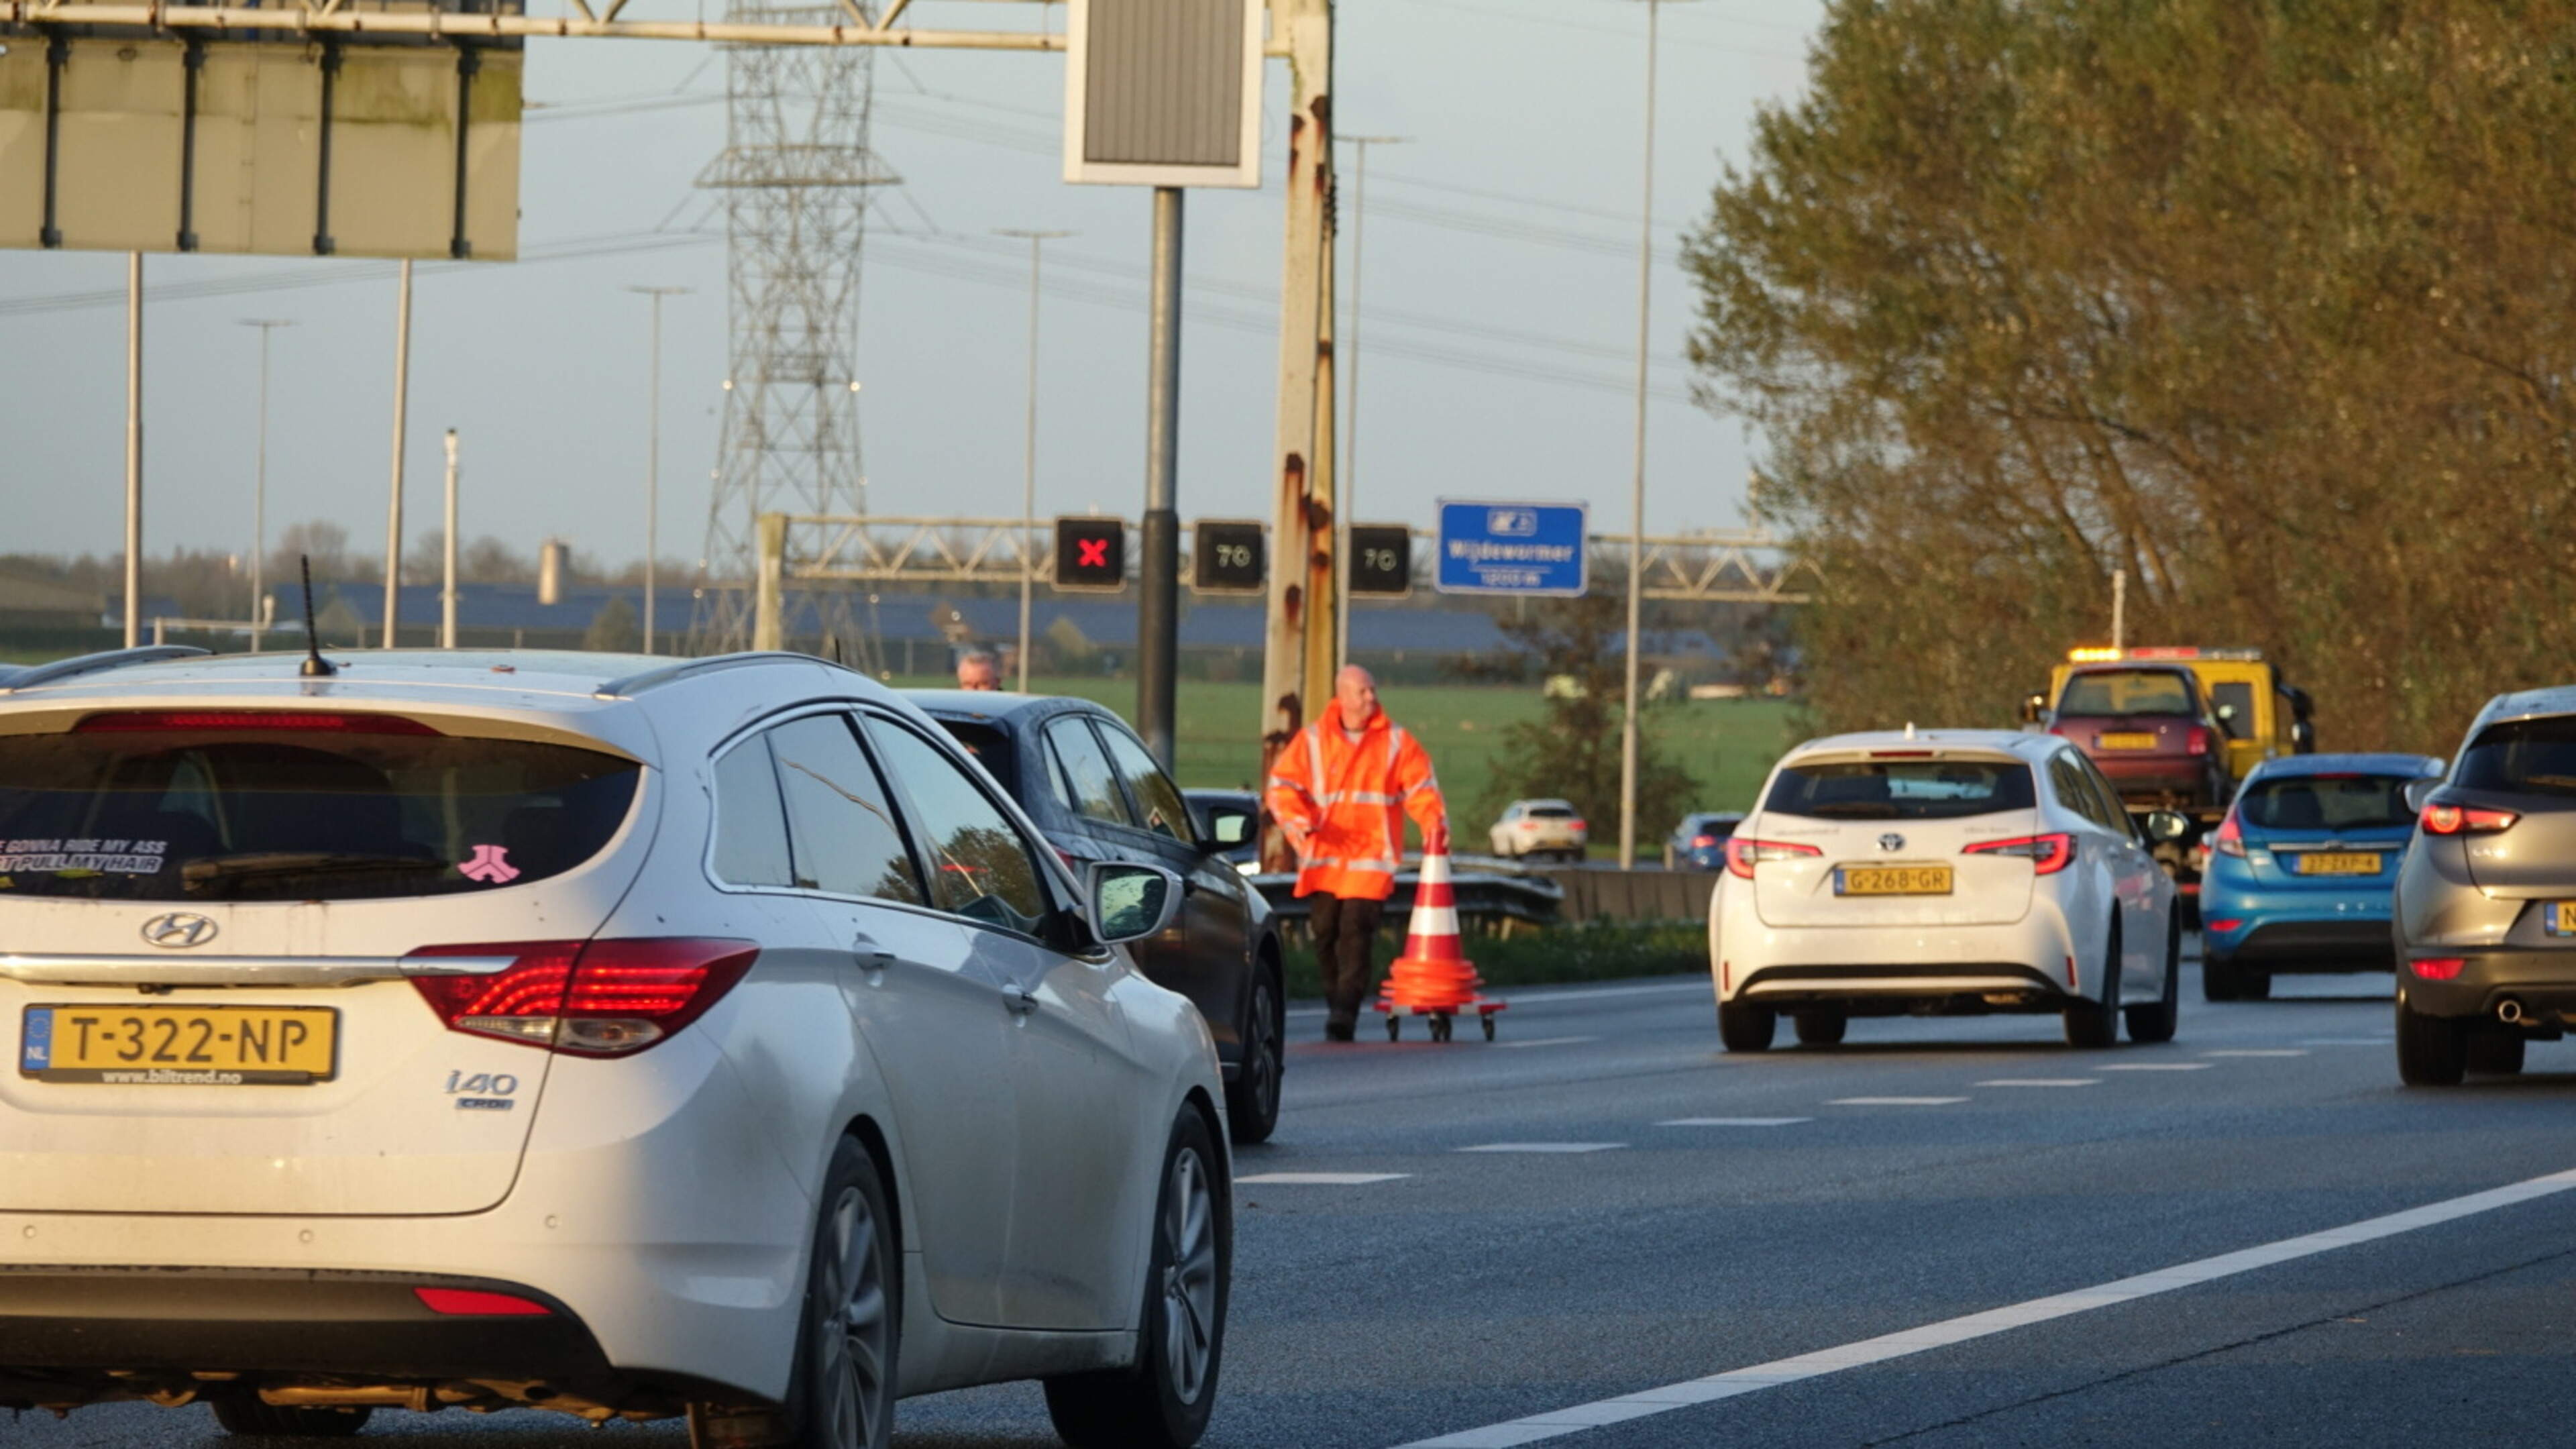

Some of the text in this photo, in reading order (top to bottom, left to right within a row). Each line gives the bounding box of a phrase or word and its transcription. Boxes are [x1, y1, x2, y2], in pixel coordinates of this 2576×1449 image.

[1216, 544, 1250, 568] 70
[1364, 548, 1397, 571] 70
[6, 840, 61, 853] GONNA
[101, 840, 130, 853] MY
[131, 841, 168, 854] ASS
[17, 855, 66, 871] PULL
[68, 855, 105, 871] MY
[107, 855, 162, 873] HAIR
[1850, 870, 1945, 889] G-268-GR
[71, 1017, 307, 1063] T-322-NP
[26, 1046, 48, 1061] NL
[102, 1069, 242, 1085] www.biltrend.no
[444, 1069, 518, 1095] i40
